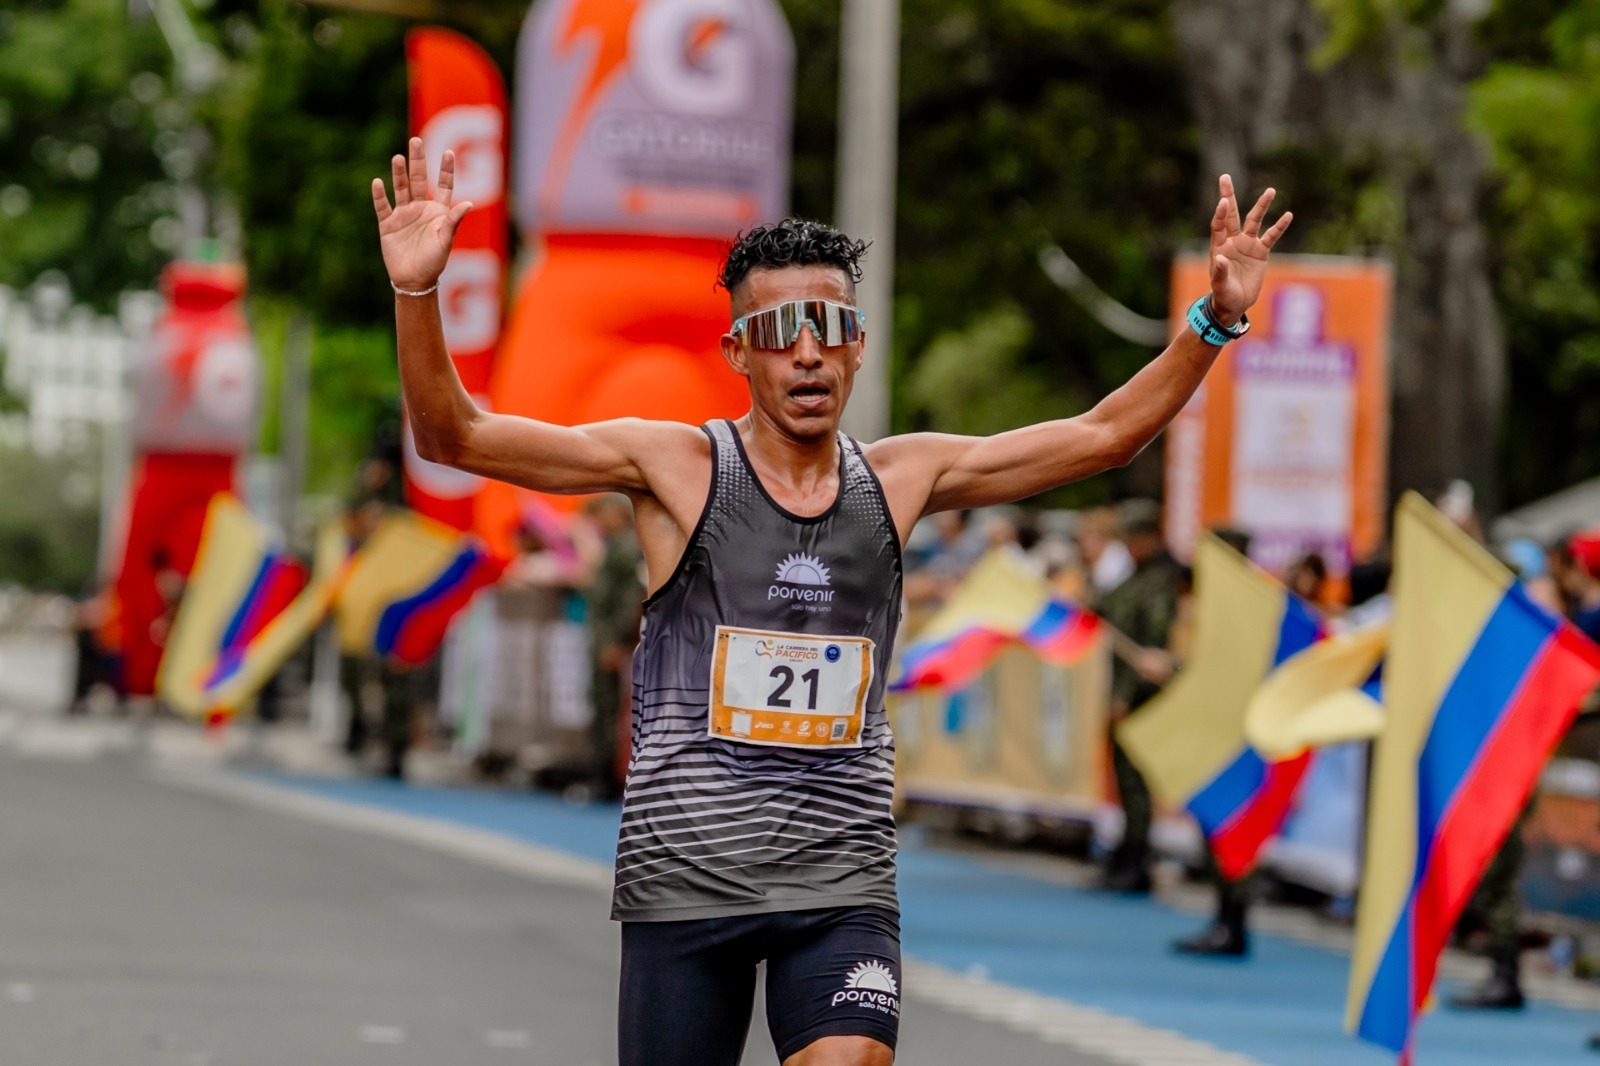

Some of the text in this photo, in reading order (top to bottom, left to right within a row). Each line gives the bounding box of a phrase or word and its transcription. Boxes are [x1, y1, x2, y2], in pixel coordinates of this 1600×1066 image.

[627, 0, 752, 114] G
[423, 105, 503, 208] G
[768, 585, 835, 602] porvenir
[805, 604, 817, 613] hay
[775, 649, 818, 660] PACIFICO
[767, 665, 819, 710] 21
[831, 990, 900, 1012] porveni
[876, 1004, 890, 1014] hay
